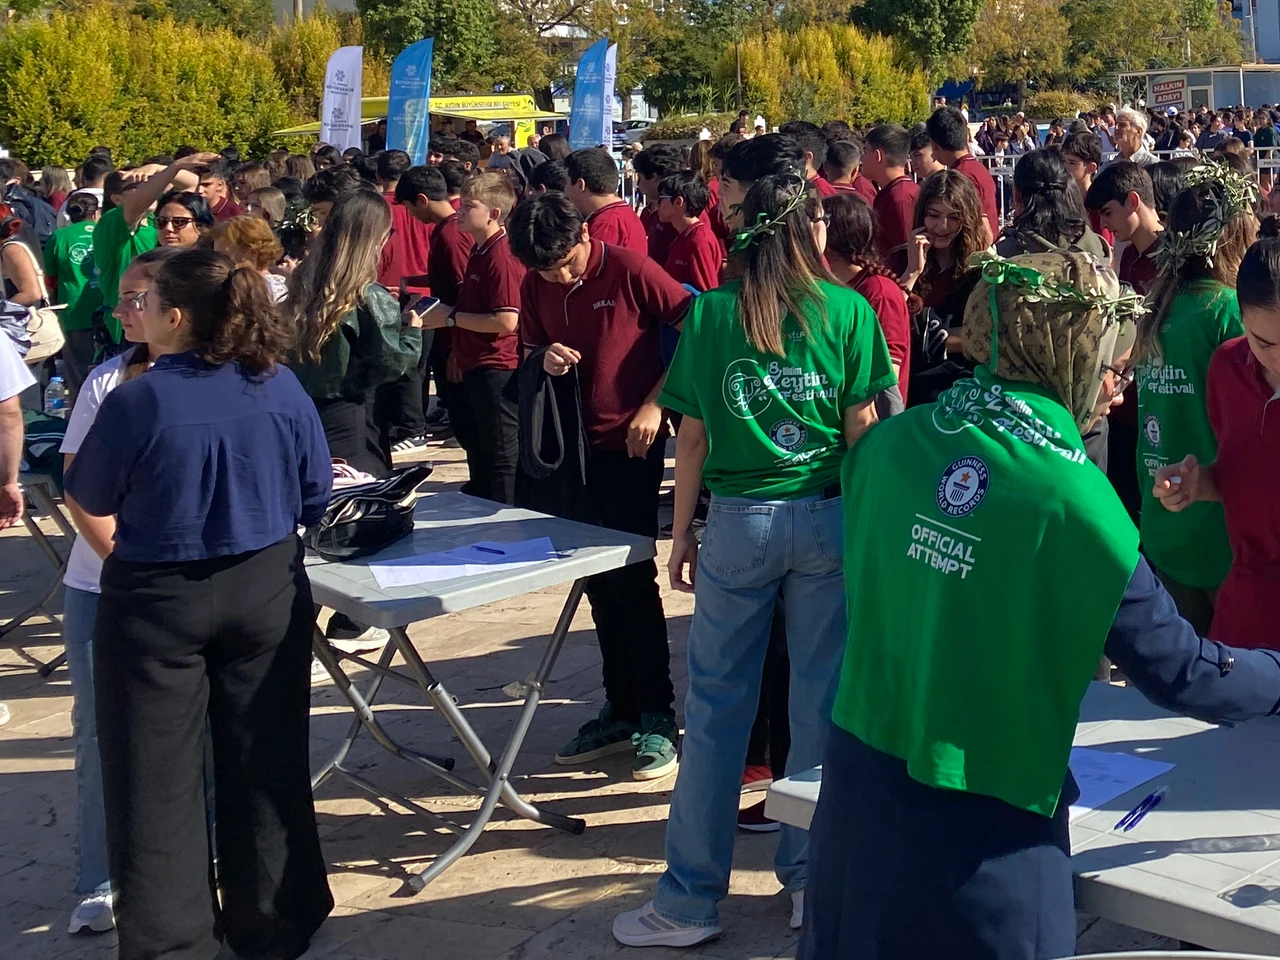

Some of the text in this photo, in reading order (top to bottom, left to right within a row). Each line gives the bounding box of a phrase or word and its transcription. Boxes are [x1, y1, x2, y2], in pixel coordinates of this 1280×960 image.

[763, 370, 829, 393] Zeytin
[951, 458, 988, 481] GUINNESS
[937, 475, 985, 515] WORLD RECORDS
[907, 542, 973, 580] ATTEMPT
[911, 524, 976, 563] OFFICIAL
